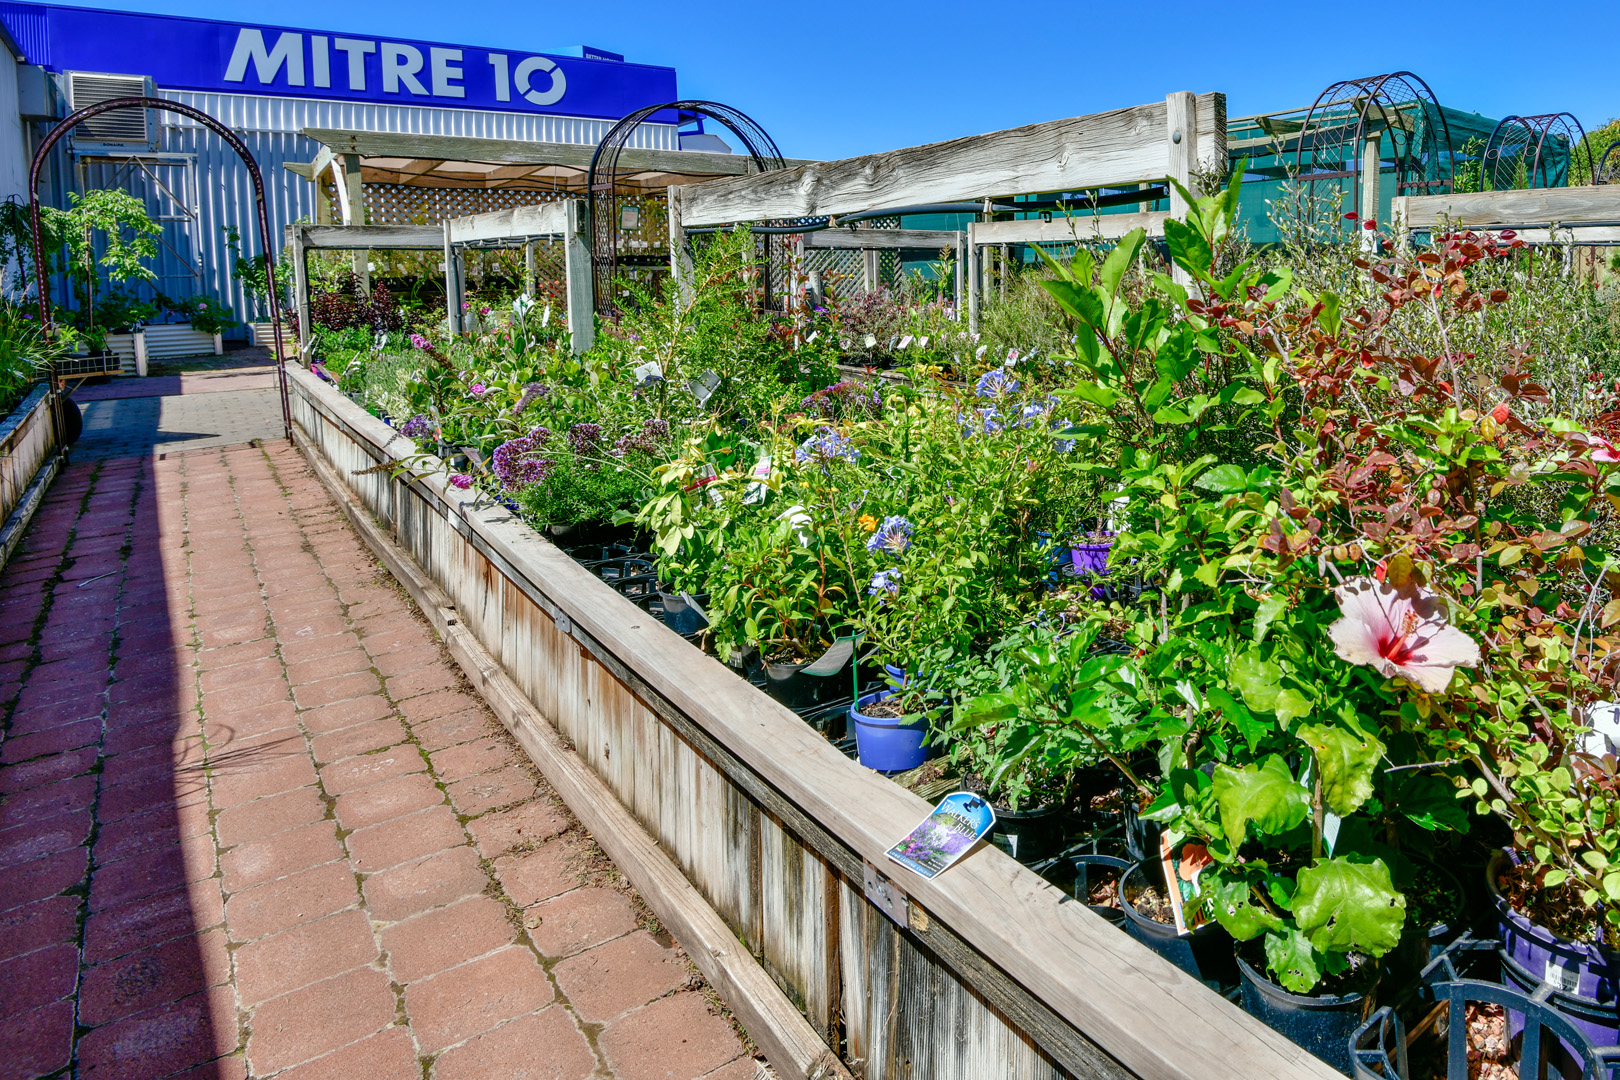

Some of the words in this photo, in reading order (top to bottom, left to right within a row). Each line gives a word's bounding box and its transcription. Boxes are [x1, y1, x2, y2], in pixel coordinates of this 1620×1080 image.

[224, 28, 466, 98] MITRE
[488, 53, 567, 106] 10
[941, 801, 981, 830] WALKER'S
[953, 823, 979, 841] BLUE
